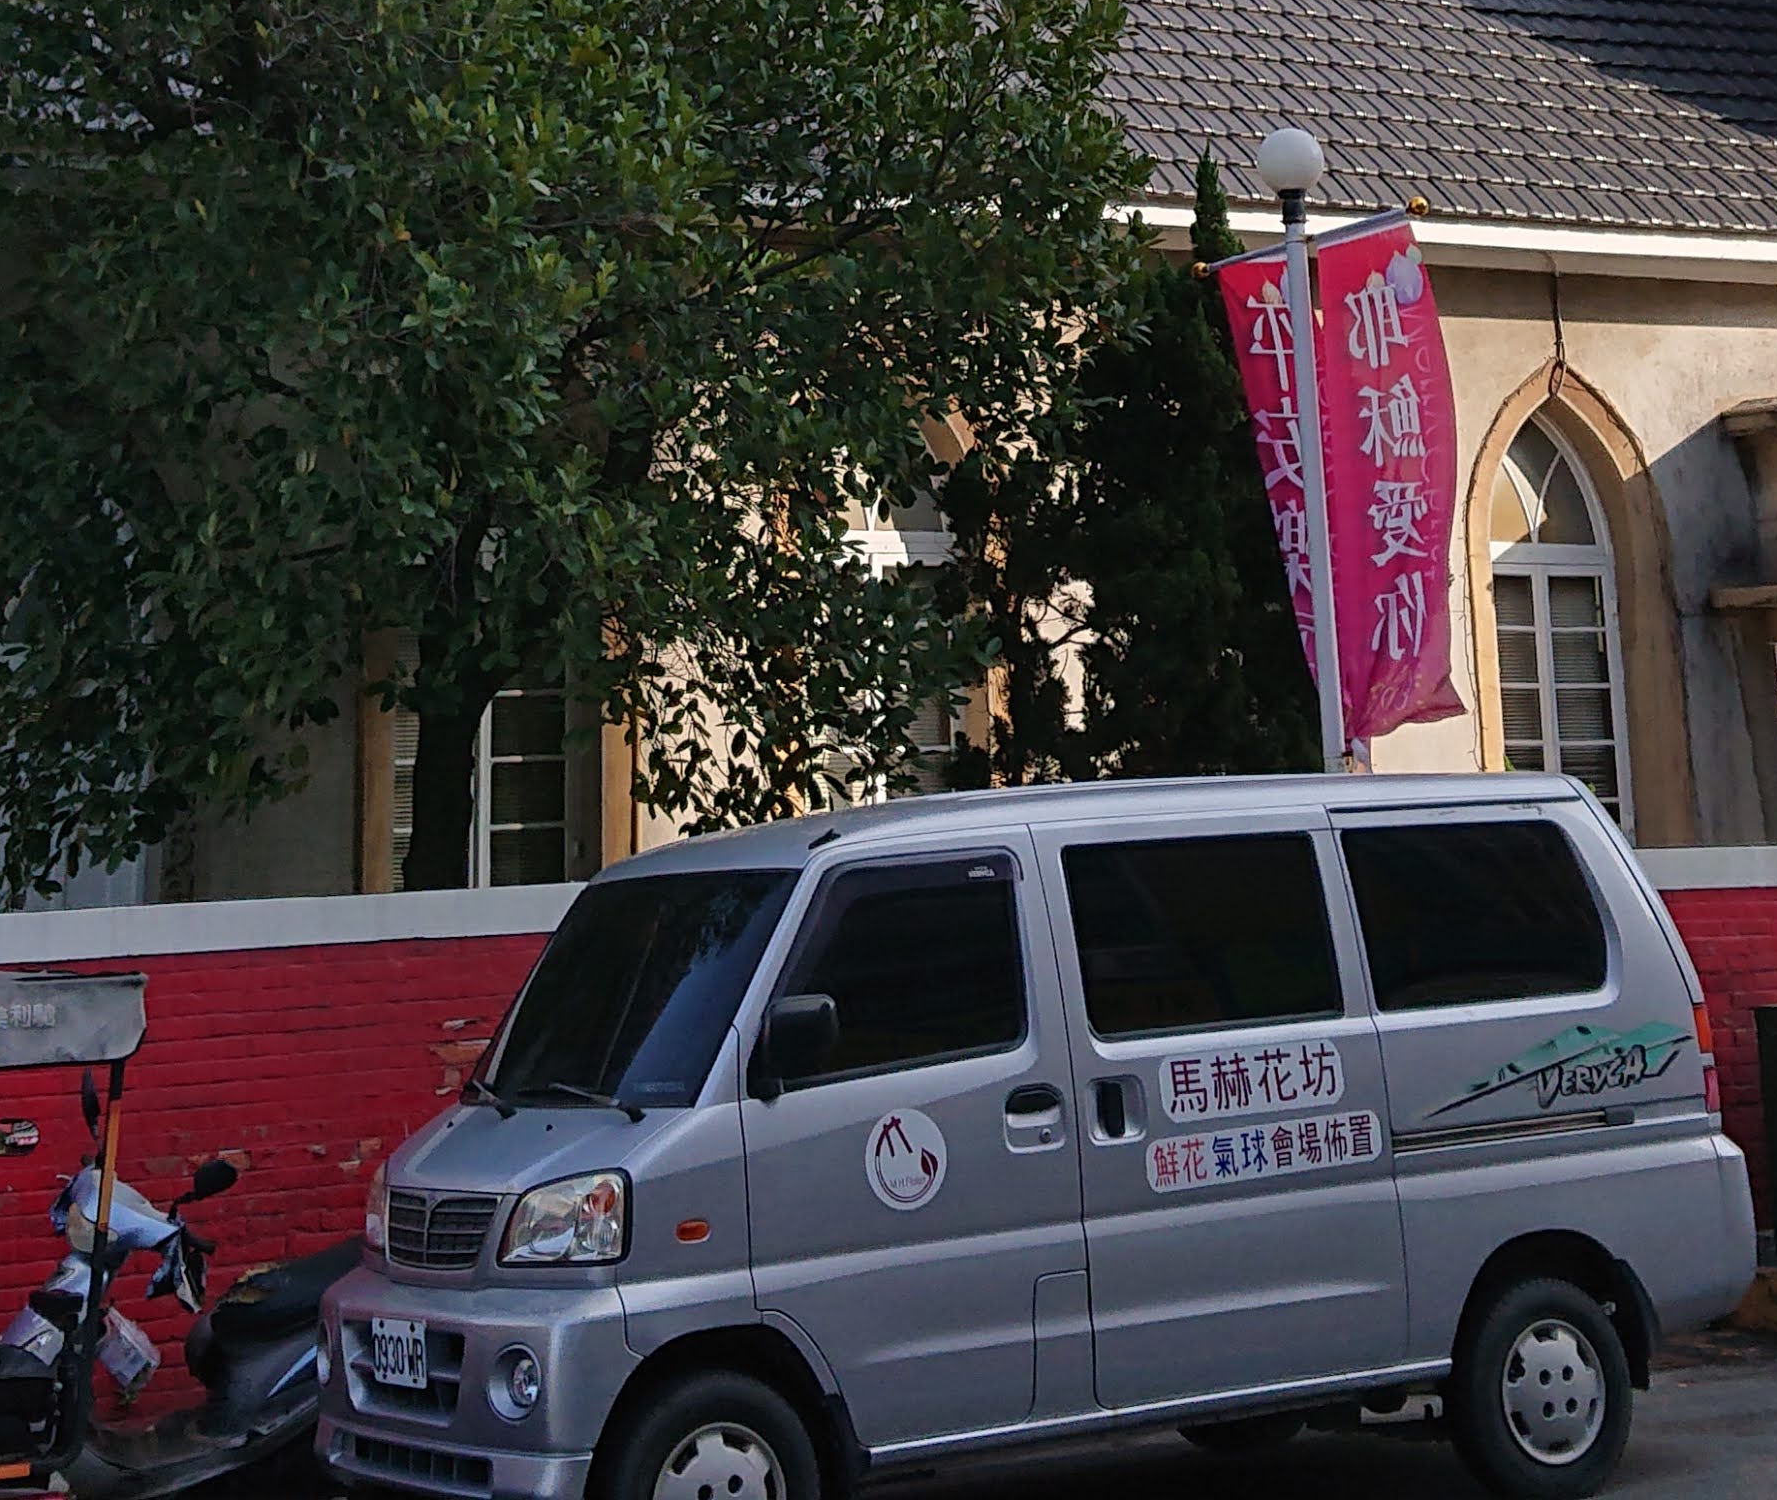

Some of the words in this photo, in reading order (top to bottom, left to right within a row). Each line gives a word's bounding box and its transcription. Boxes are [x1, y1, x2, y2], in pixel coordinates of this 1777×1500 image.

[1169, 1042, 1337, 1115] 馬赫花坊
[1536, 1044, 1648, 1109] VERYCA
[1153, 1114, 1374, 1188] 鮮花氣球會場佈置
